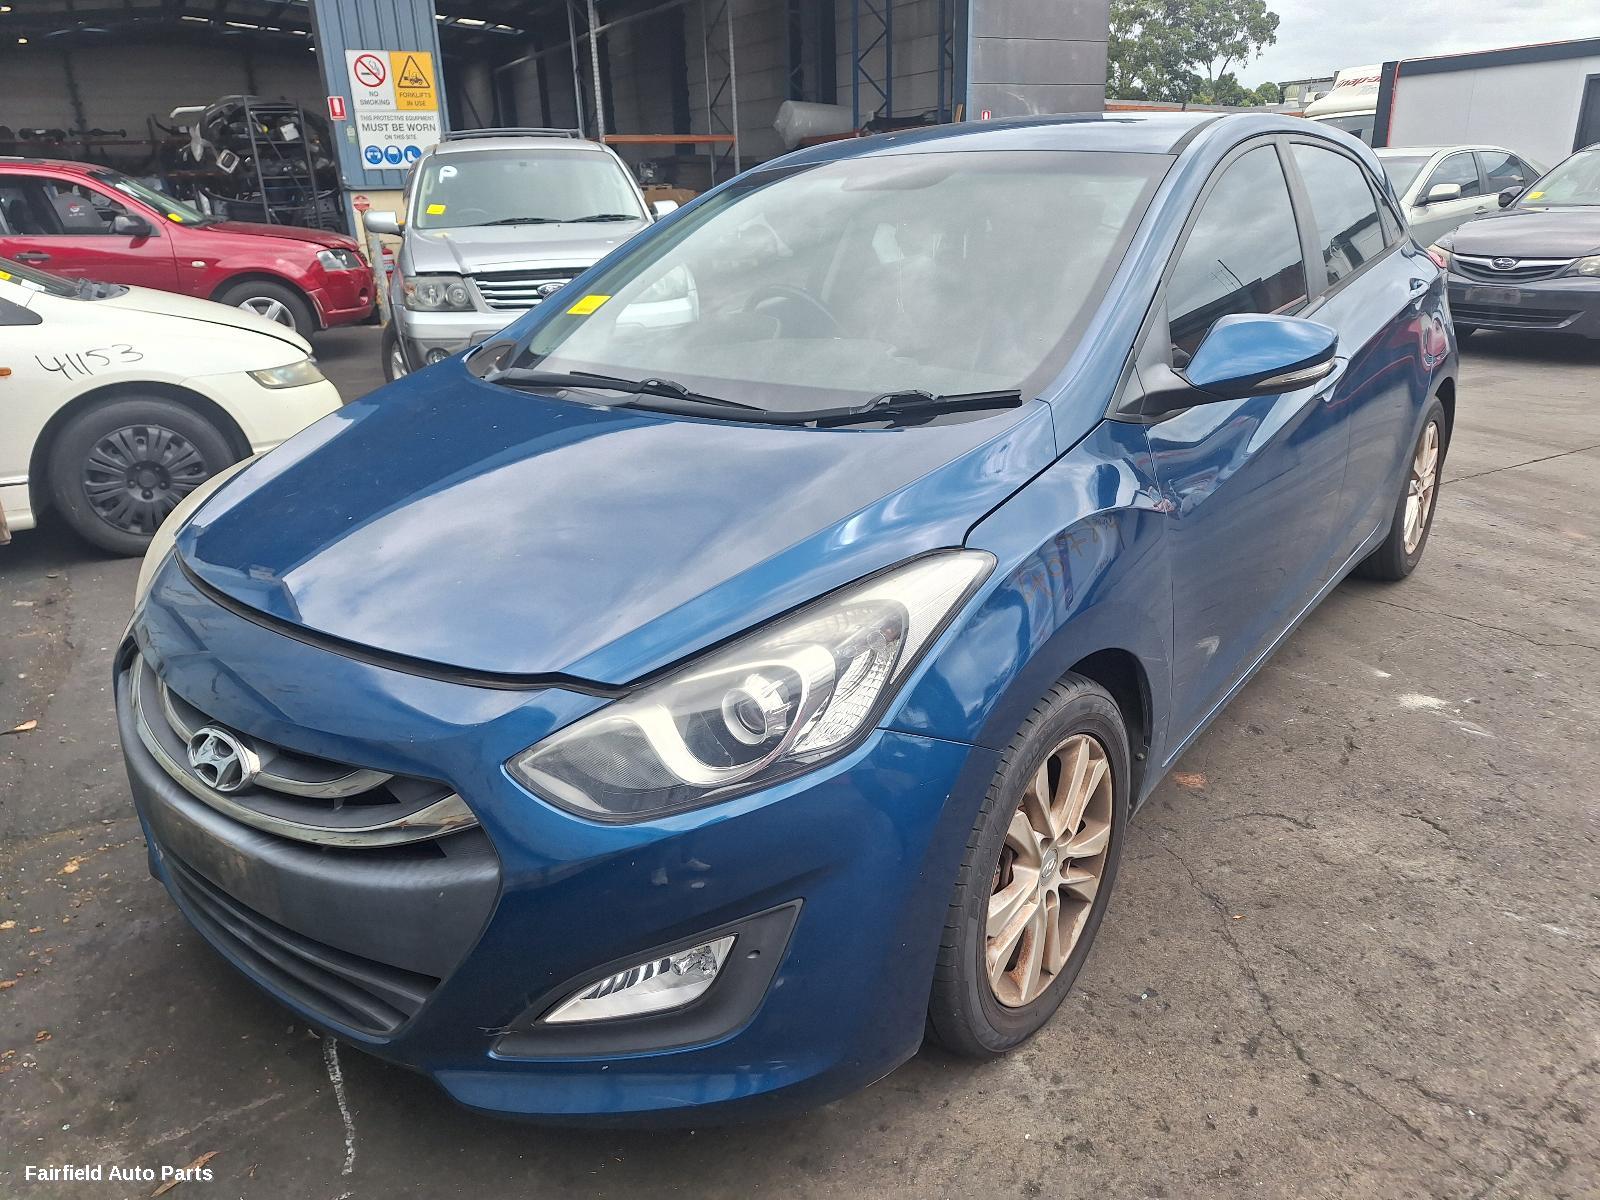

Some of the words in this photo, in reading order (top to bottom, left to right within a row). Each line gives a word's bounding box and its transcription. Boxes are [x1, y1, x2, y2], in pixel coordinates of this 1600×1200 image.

[361, 123, 389, 131] MUST
[391, 123, 405, 131] BE
[407, 123, 437, 131] WORN
[34, 343, 144, 381] 41153
